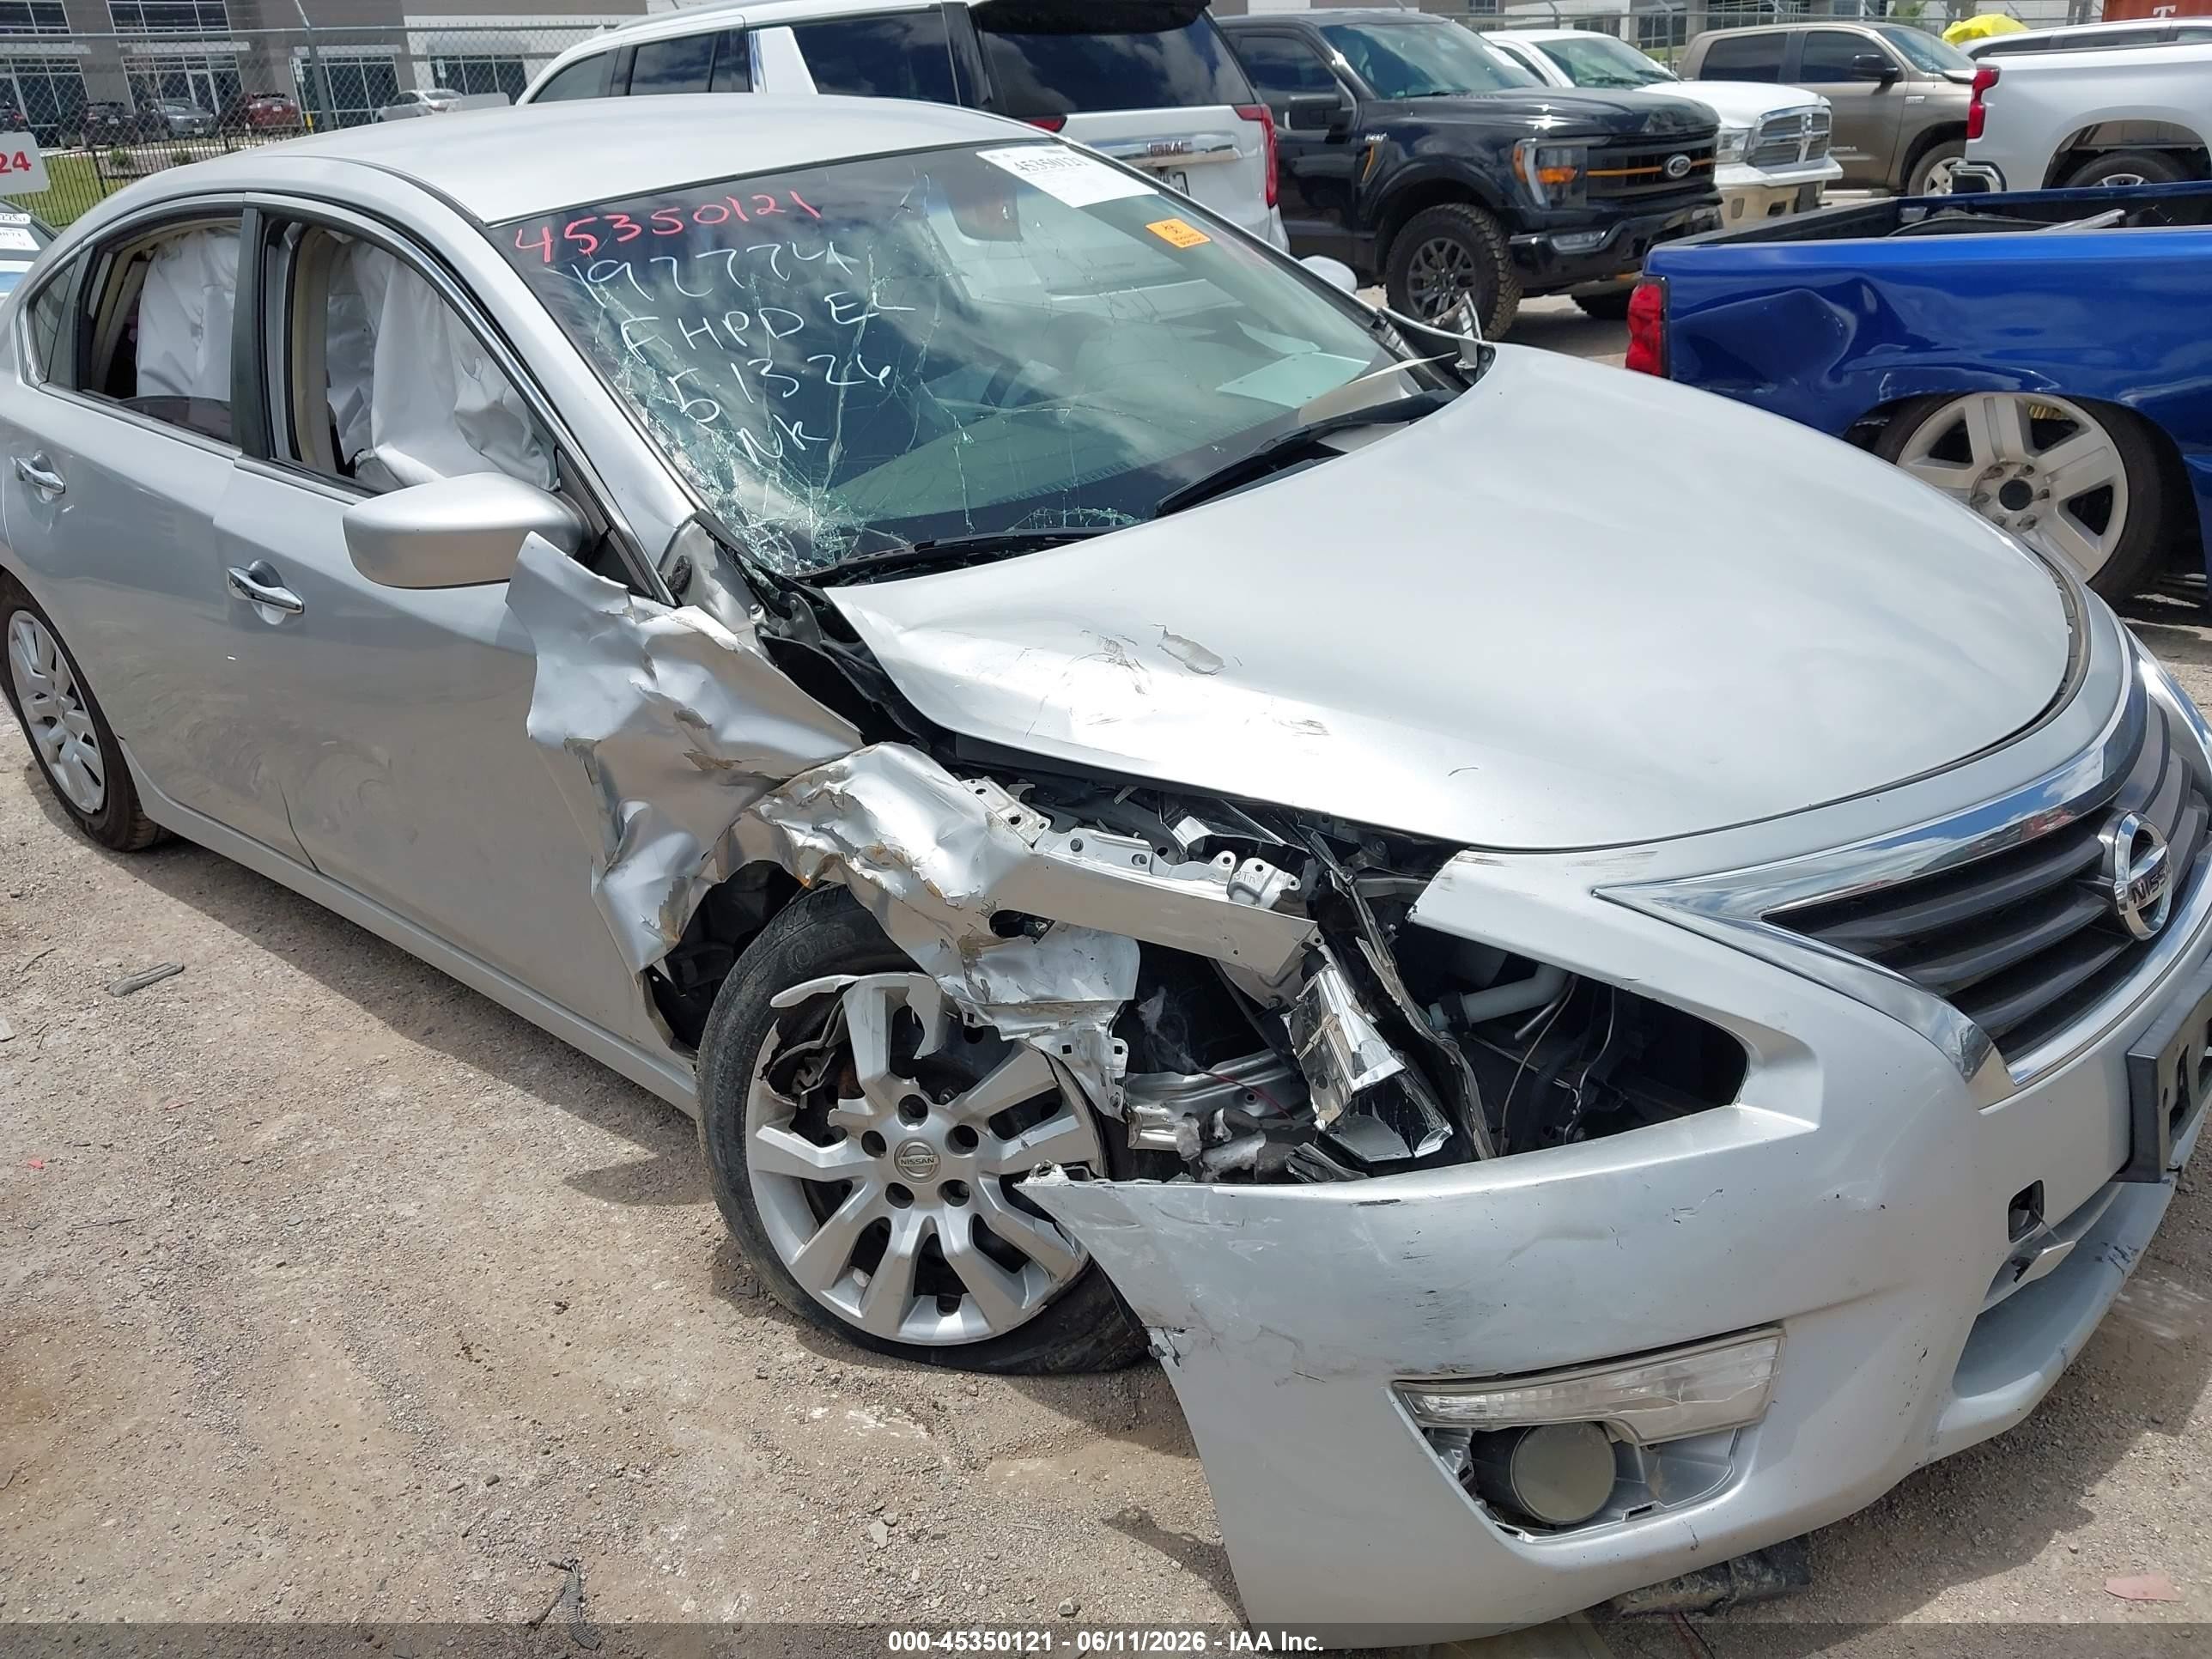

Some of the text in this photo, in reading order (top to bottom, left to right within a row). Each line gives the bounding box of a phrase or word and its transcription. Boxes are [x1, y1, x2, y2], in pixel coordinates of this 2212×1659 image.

[515, 191, 821, 263] 45350121
[2129, 860, 2172, 904] NISSA
[900, 1157, 934, 1165] NISSAN
